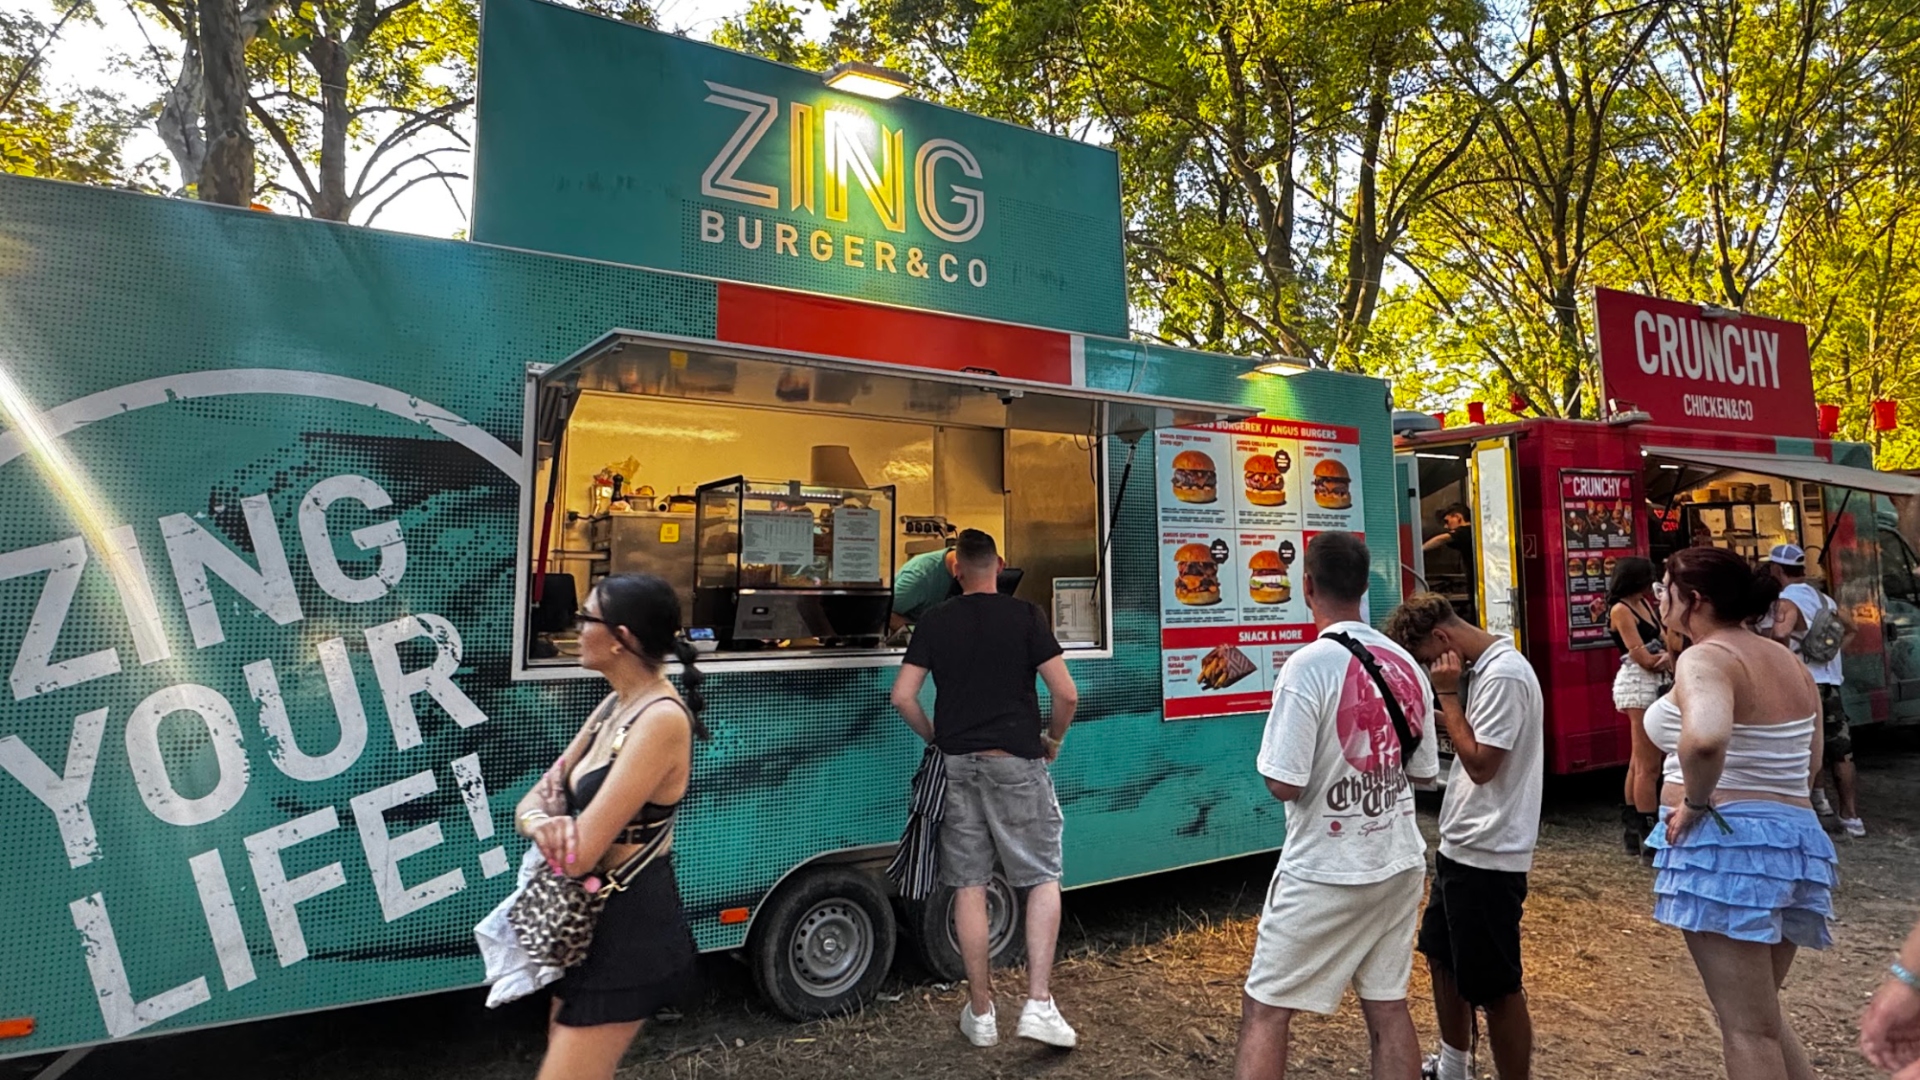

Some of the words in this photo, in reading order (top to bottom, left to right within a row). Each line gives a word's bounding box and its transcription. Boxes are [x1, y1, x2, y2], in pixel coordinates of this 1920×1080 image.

[701, 80, 984, 243] ZING
[701, 209, 988, 288] BURGER&CO
[1634, 310, 1780, 389] CRUNCHY
[1270, 424, 1298, 436] ANGUS
[1300, 428, 1337, 440] BURGERS
[1683, 393, 1754, 421] CHICKEN&CO
[1573, 476, 1621, 497] CRUNCHY
[0, 474, 407, 700] ZING
[1238, 630, 1269, 642] SNACK
[1271, 630, 1277, 640] &
[1280, 629, 1303, 640] MORE
[0, 613, 489, 870] YOUR
[69, 752, 510, 1038] LIFE!
